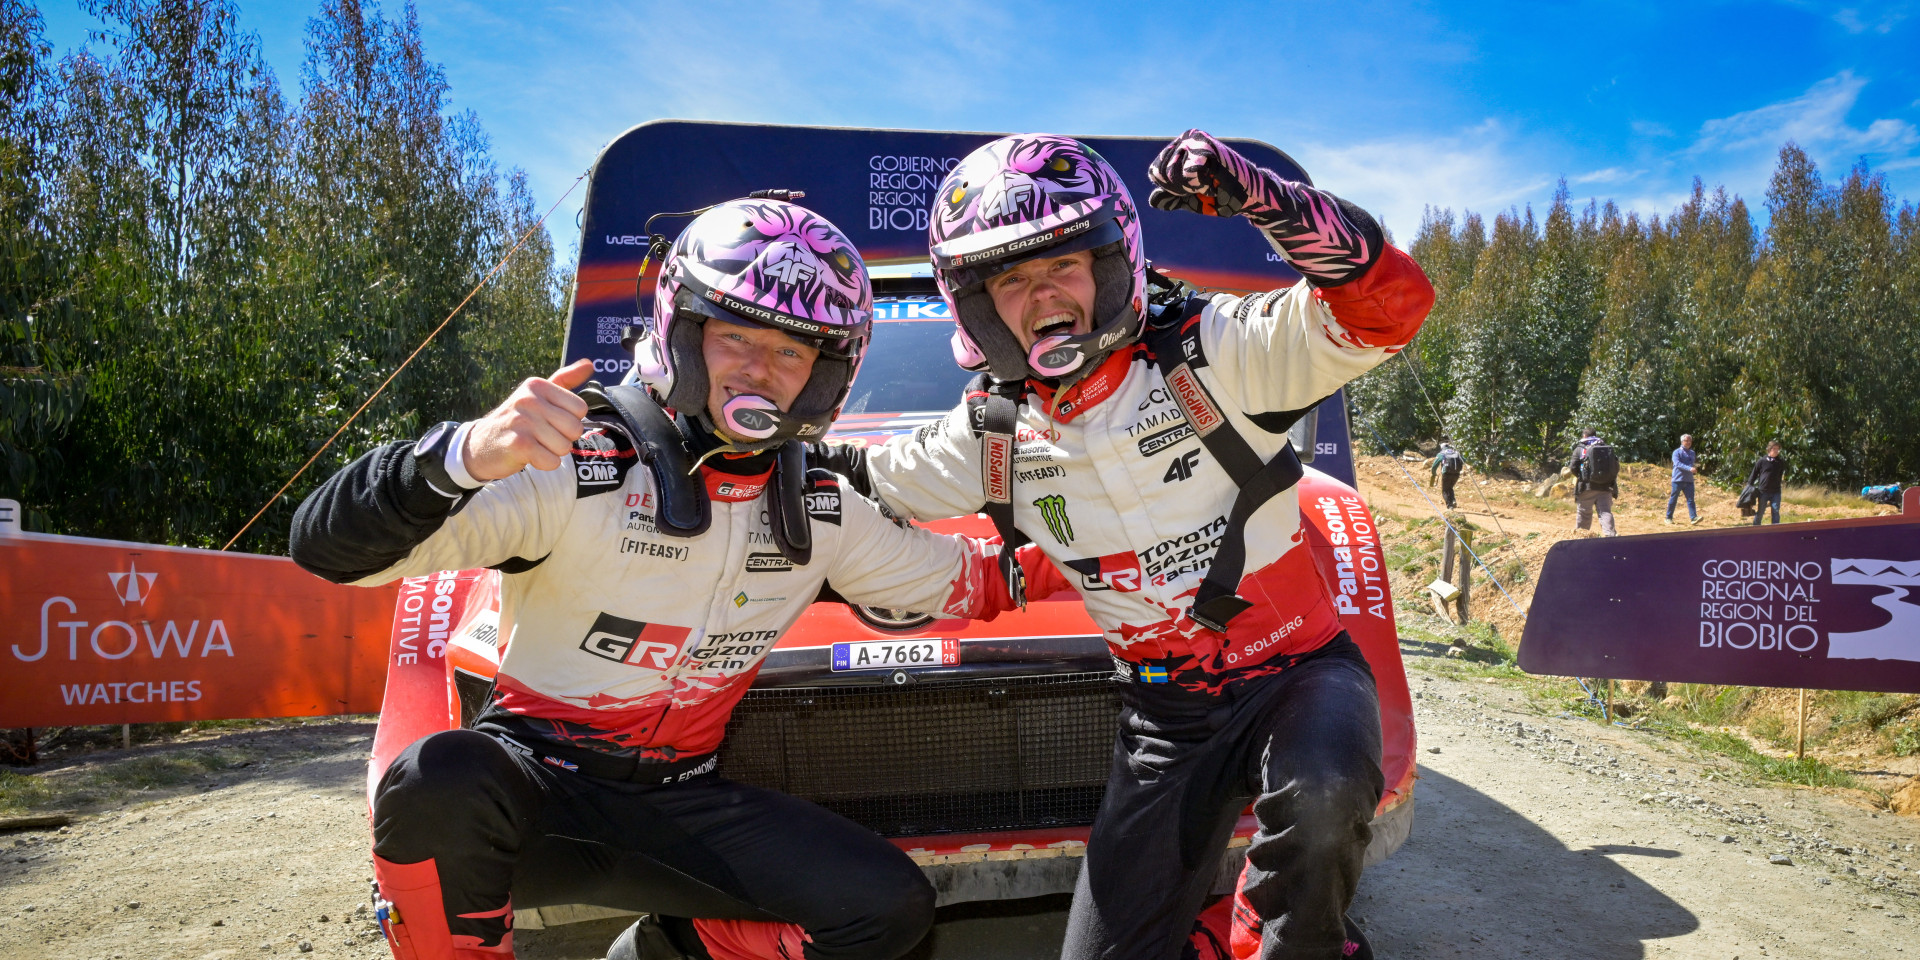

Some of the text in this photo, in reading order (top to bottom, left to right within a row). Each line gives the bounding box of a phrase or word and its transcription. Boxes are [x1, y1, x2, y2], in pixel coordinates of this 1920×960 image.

[869, 191, 926, 206] REGION
[869, 207, 930, 231] BIOB
[606, 234, 650, 246] WRC
[963, 247, 1005, 264] TOYOTA
[1008, 233, 1053, 252] GAZOO
[1054, 219, 1090, 237] Racing
[724, 296, 771, 320] TOYOTA
[774, 315, 819, 333] GAZOO
[820, 325, 850, 338] Racing
[1099, 327, 1127, 350] Oliver
[1174, 374, 1214, 426] SIMPSON
[1014, 428, 1062, 443] ENSO
[1125, 408, 1182, 438] TAMAD
[1013, 444, 1052, 455] anasonic
[1139, 426, 1195, 455] CENTRA
[577, 464, 618, 481] OMP
[990, 441, 1005, 496] SIMPSON
[1163, 448, 1201, 484] 4F
[1138, 515, 1229, 565] TOYOTA
[1315, 496, 1361, 616] Panasonic
[1341, 496, 1386, 620] AUTOMOTIVE
[1702, 559, 1822, 581] GOBIERNO
[1151, 556, 1215, 587] Racin
[1702, 580, 1821, 603] REGIONAL
[1700, 602, 1818, 622] REGION DEL
[12, 596, 235, 662] STOWA
[1227, 615, 1304, 664] O. SOLBERG
[1699, 621, 1819, 652] BIOBIO
[584, 631, 679, 669] GR
[856, 644, 935, 666] A-7662
[943, 640, 955, 650] 11
[943, 653, 956, 664] 26
[60, 680, 202, 706] WATCHES
